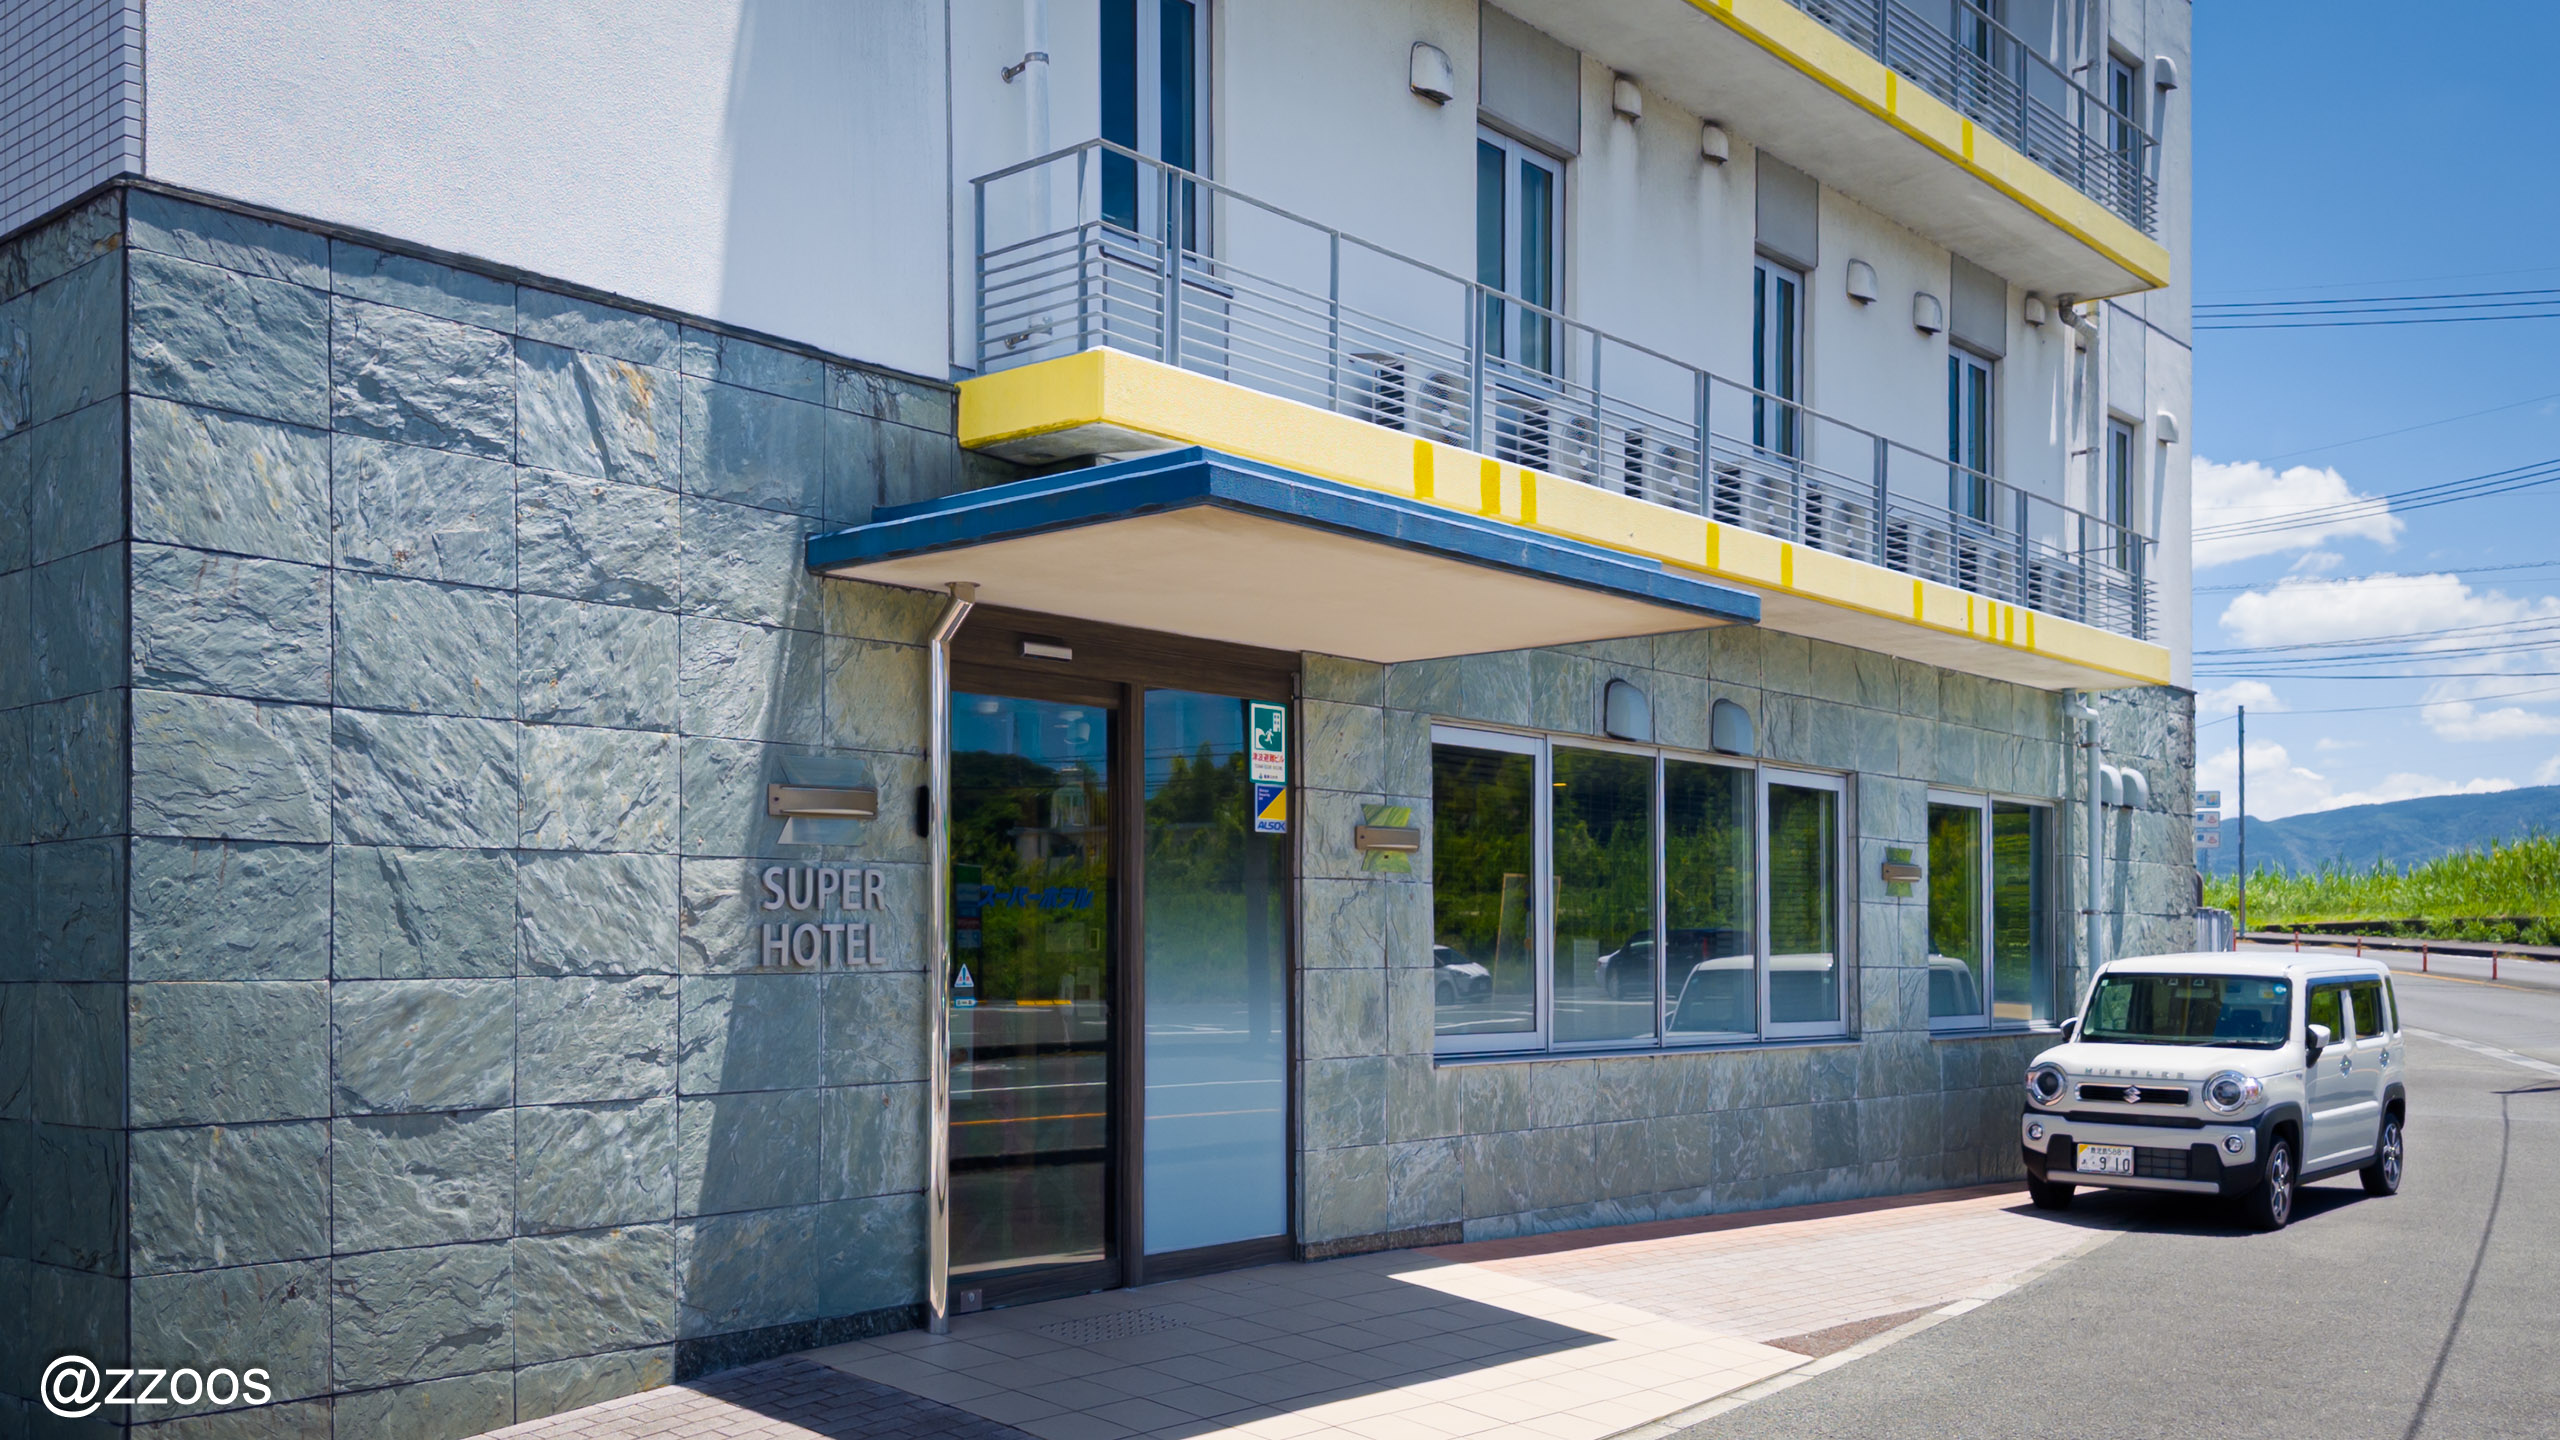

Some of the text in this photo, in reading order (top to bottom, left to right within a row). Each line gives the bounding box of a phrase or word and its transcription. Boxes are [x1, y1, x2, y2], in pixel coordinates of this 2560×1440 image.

[1257, 821, 1286, 831] ALSOK
[761, 866, 886, 911] SUPER
[761, 923, 887, 968] HOTEL
